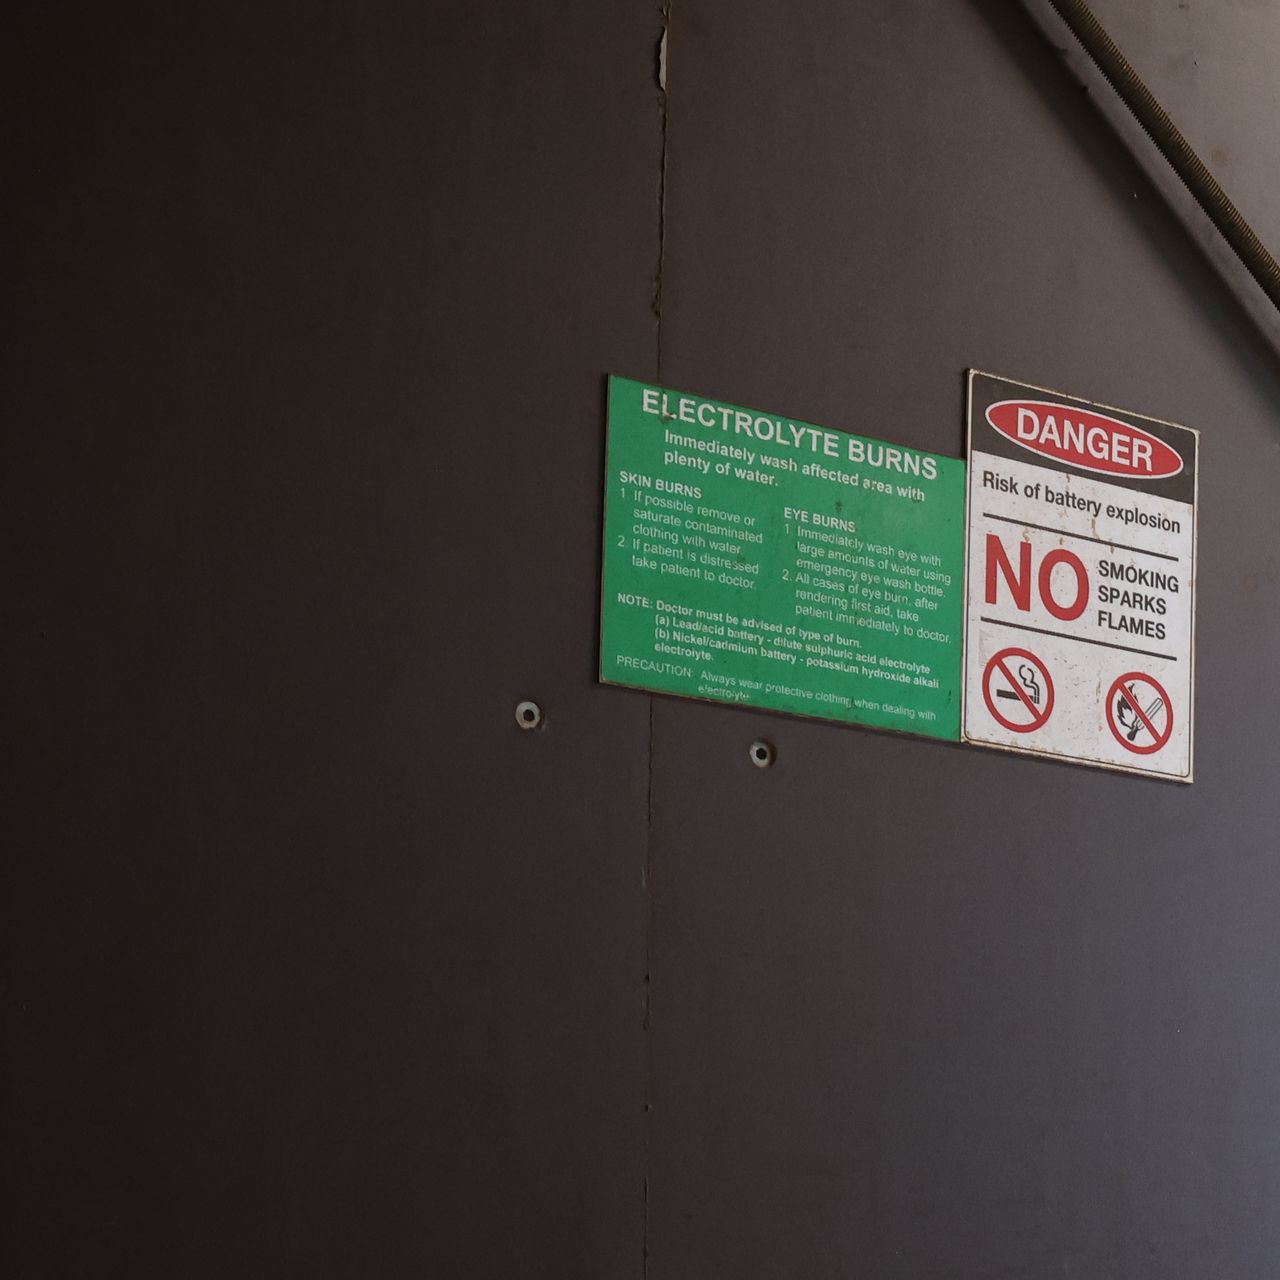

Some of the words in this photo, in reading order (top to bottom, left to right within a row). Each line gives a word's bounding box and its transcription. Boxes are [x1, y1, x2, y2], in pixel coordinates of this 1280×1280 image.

[642, 388, 839, 457] ELECTROLYTE
[848, 438, 938, 480] BURNS
[1016, 407, 1153, 472] DANGER
[664, 429, 755, 465] Immediately
[760, 453, 798, 472] wash
[802, 463, 859, 486] affected
[862, 477, 892, 494] area
[896, 485, 926, 502] with
[664, 450, 711, 474] plenty
[715, 461, 731, 475] of
[734, 467, 778, 487] water.
[619, 471, 651, 488] SKIN
[655, 479, 703, 499] BURNS
[983, 470, 1019, 496] Risk
[1024, 483, 1041, 499] of
[1045, 485, 1101, 518] battery
[1106, 504, 1181, 534] explosion
[633, 508, 681, 527] saturate
[684, 518, 764, 544] contaminated
[634, 490, 643, 502] If
[645, 494, 694, 514] possible
[697, 506, 740, 524] remove
[743, 516, 756, 527] or
[784, 507, 809, 523] EYE
[812, 514, 856, 533] BURNS
[632, 524, 679, 545] clothing
[682, 534, 706, 548] with
[797, 526, 864, 552] Immediately
[866, 543, 895, 557] wash
[897, 549, 918, 562] eye
[920, 554, 941, 567] with
[632, 538, 641, 550] If
[643, 543, 683, 561] patient
[687, 550, 697, 562] is
[700, 553, 760, 575] distressed
[632, 555, 657, 569] take
[660, 562, 700, 578] patient
[703, 568, 715, 581] to
[796, 541, 825, 557] large
[828, 551, 875, 568] amounts
[878, 559, 890, 571] of
[891, 563, 921, 577] water
[923, 571, 951, 586] using
[796, 558, 858, 581] emergency
[860, 572, 881, 585] eye
[883, 576, 912, 591] wash
[795, 571, 810, 584] All
[812, 576, 845, 592] cases
[848, 583, 860, 595] of
[861, 587, 882, 600] eye
[914, 597, 939, 610] after
[985, 533, 1089, 621] NO
[1098, 559, 1180, 593] SMOKING
[795, 589, 848, 610] rendering
[851, 600, 872, 614] first
[896, 608, 919, 622] take
[1097, 585, 1167, 615] SPARKS
[617, 592, 653, 609] NOTE:
[656, 600, 693, 616] Doctor
[696, 608, 723, 622] must
[726, 613, 739, 625] be
[741, 617, 783, 634] advised
[785, 626, 796, 637] of
[799, 628, 821, 642] type
[823, 632, 835, 643] of
[836, 635, 862, 649] burn.
[795, 604, 833, 621] patient
[835, 611, 900, 636] immediately
[903, 624, 914, 637] to
[1097, 610, 1166, 640] FLAMES
[654, 643, 714, 662] electrolyte.
[654, 627, 670, 641] (b)
[672, 631, 758, 656] Nickel/cadmium
[760, 648, 797, 665] battery
[806, 656, 859, 675] potassium
[861, 665, 911, 684] hydroxide
[913, 676, 940, 690] alkali
[655, 614, 670, 628] (a)
[672, 616, 725, 637] Lead/acid
[727, 626, 765, 646] battery
[773, 636, 803, 650] dilute
[805, 642, 853, 661] sulphuric
[855, 652, 877, 665] acid
[879, 656, 931, 675] electrolyte
[616, 655, 694, 678] PRECAUTION:
[700, 670, 736, 687] Always
[738, 679, 763, 690] wear
[765, 682, 813, 700] protective
[815, 691, 851, 708] clothing
[854, 699, 880, 711] when
[881, 703, 916, 719] dealing
[917, 710, 936, 722] with
